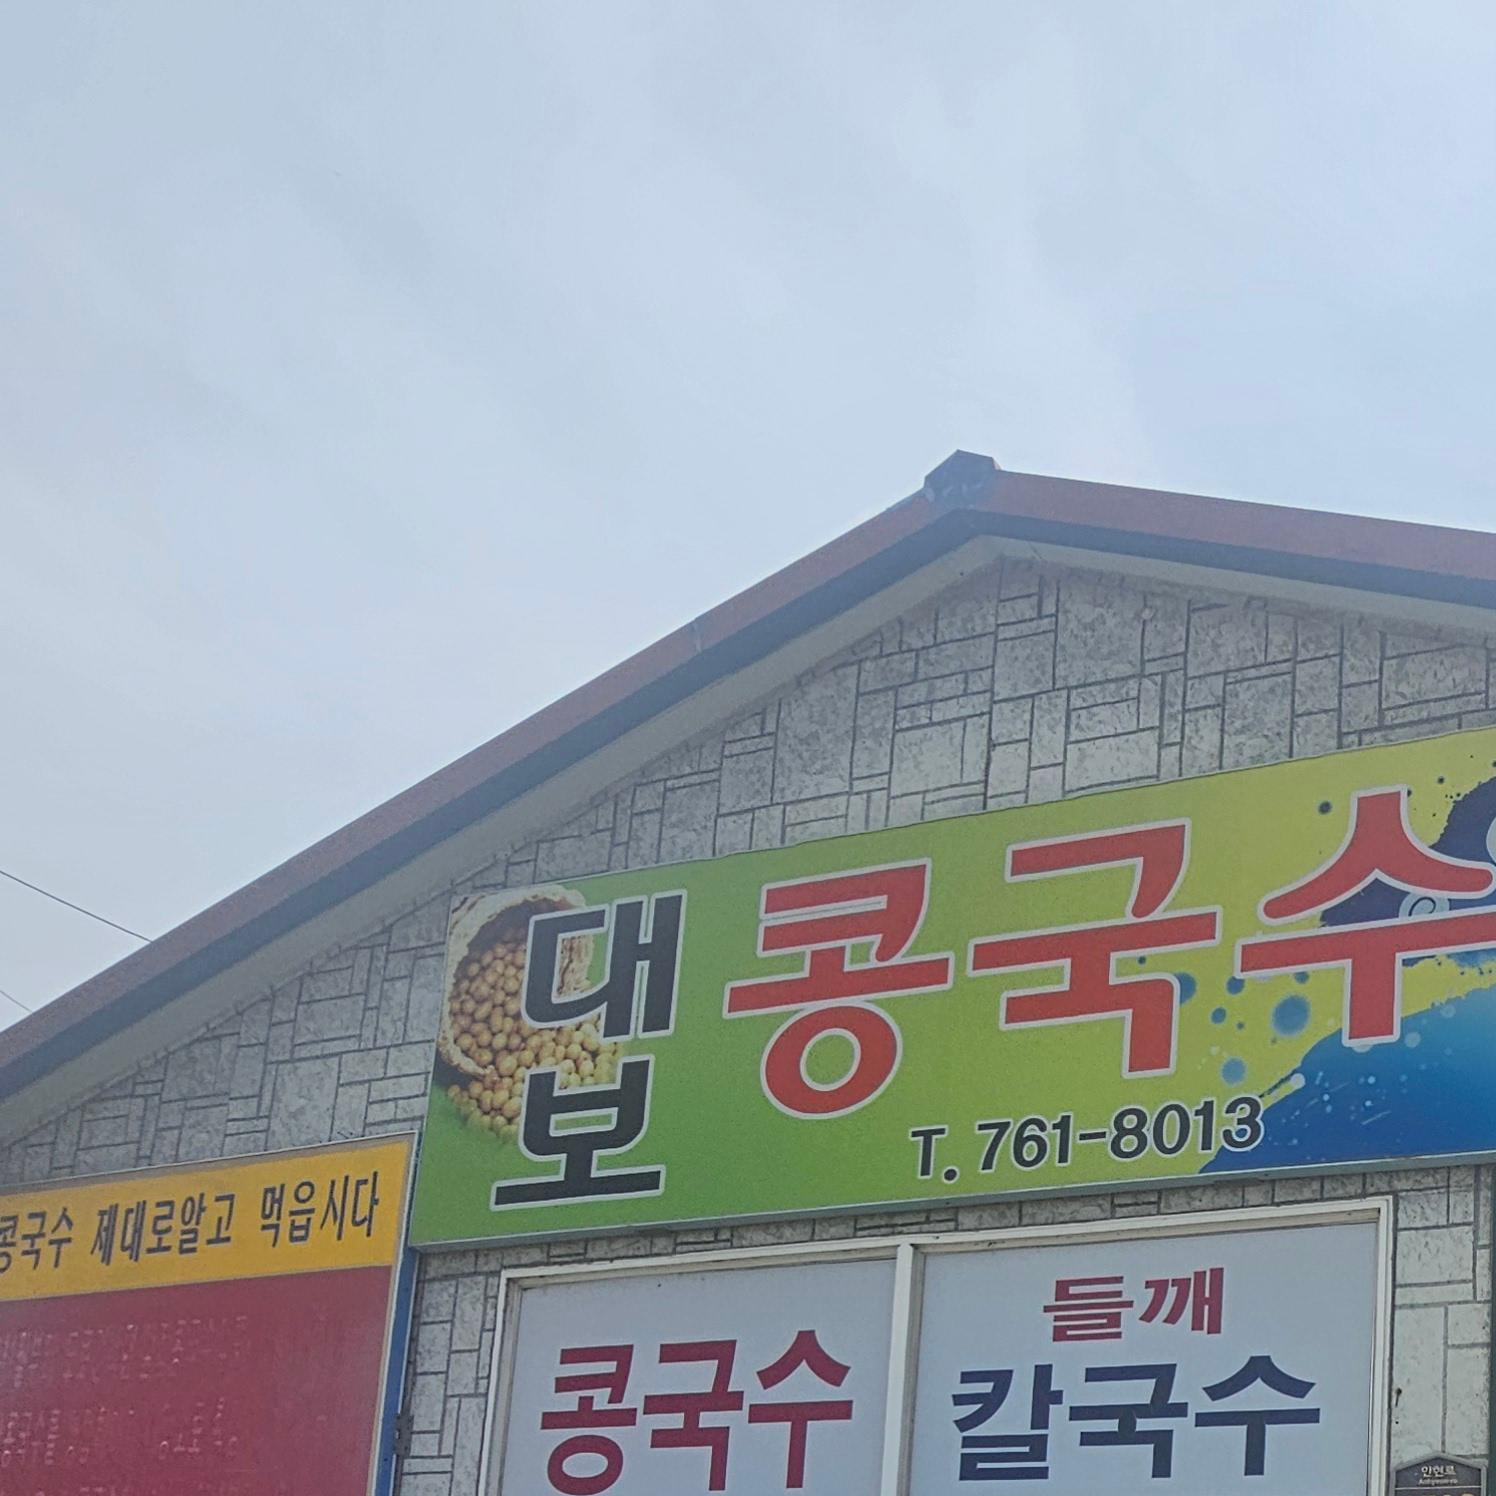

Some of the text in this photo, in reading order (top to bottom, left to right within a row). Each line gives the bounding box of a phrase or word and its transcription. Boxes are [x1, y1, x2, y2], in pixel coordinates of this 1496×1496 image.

[490, 889, 685, 1209] 대보
[911, 1095, 1264, 1183] T. 761-8013
[91, 1192, 237, 1266] 제대로알고
[260, 1171, 380, 1249] 먹읍시다
[1042, 1266, 1225, 1342] 들깨
[540, 1329, 855, 1496] 콩국수
[950, 1354, 1321, 1482] 칼국수
